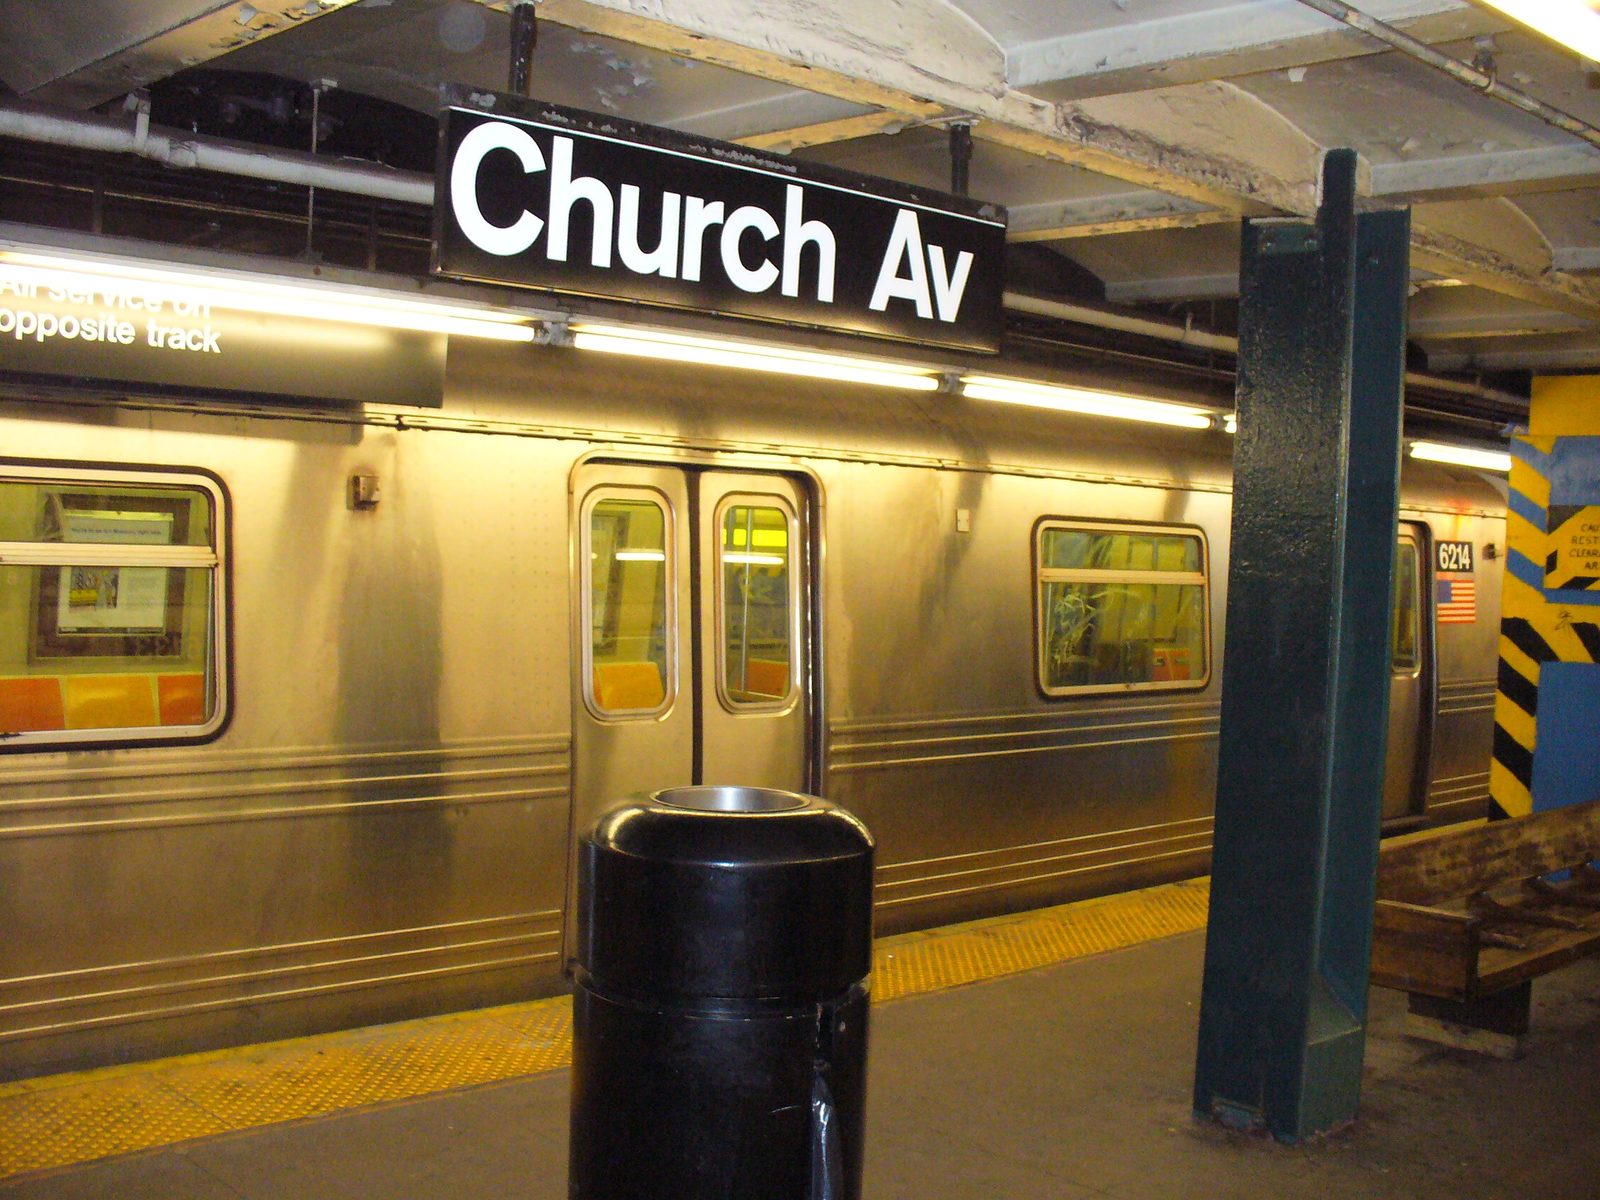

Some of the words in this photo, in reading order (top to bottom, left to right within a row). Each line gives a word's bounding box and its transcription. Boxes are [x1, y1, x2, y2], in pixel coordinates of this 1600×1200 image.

[450, 121, 836, 303] Church
[868, 208, 974, 322] Av
[0, 307, 136, 344] opposite
[146, 316, 222, 354] track
[1439, 542, 1471, 570] 6214
[1569, 548, 1600, 558] CLEAR
